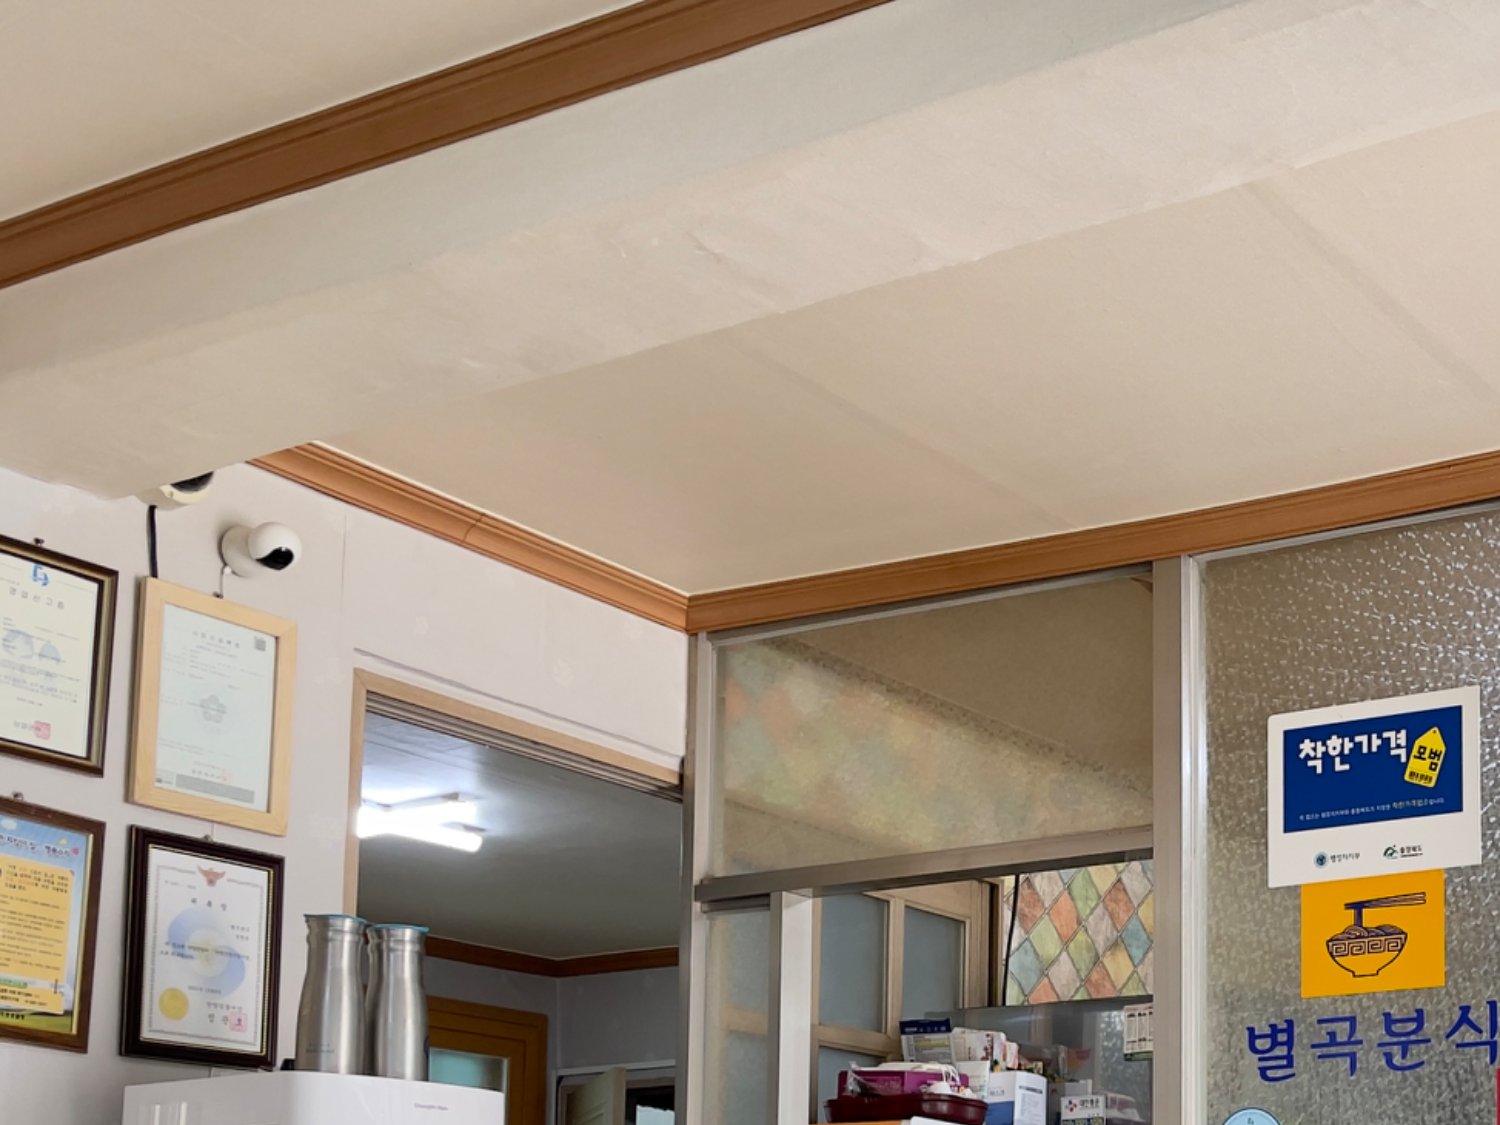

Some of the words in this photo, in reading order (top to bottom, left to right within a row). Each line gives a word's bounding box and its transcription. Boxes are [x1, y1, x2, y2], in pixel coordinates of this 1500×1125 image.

[1298, 729, 1407, 774] 착한가격
[1413, 745, 1442, 771] 모범
[1246, 1000, 1499, 1082] 별곡분식
